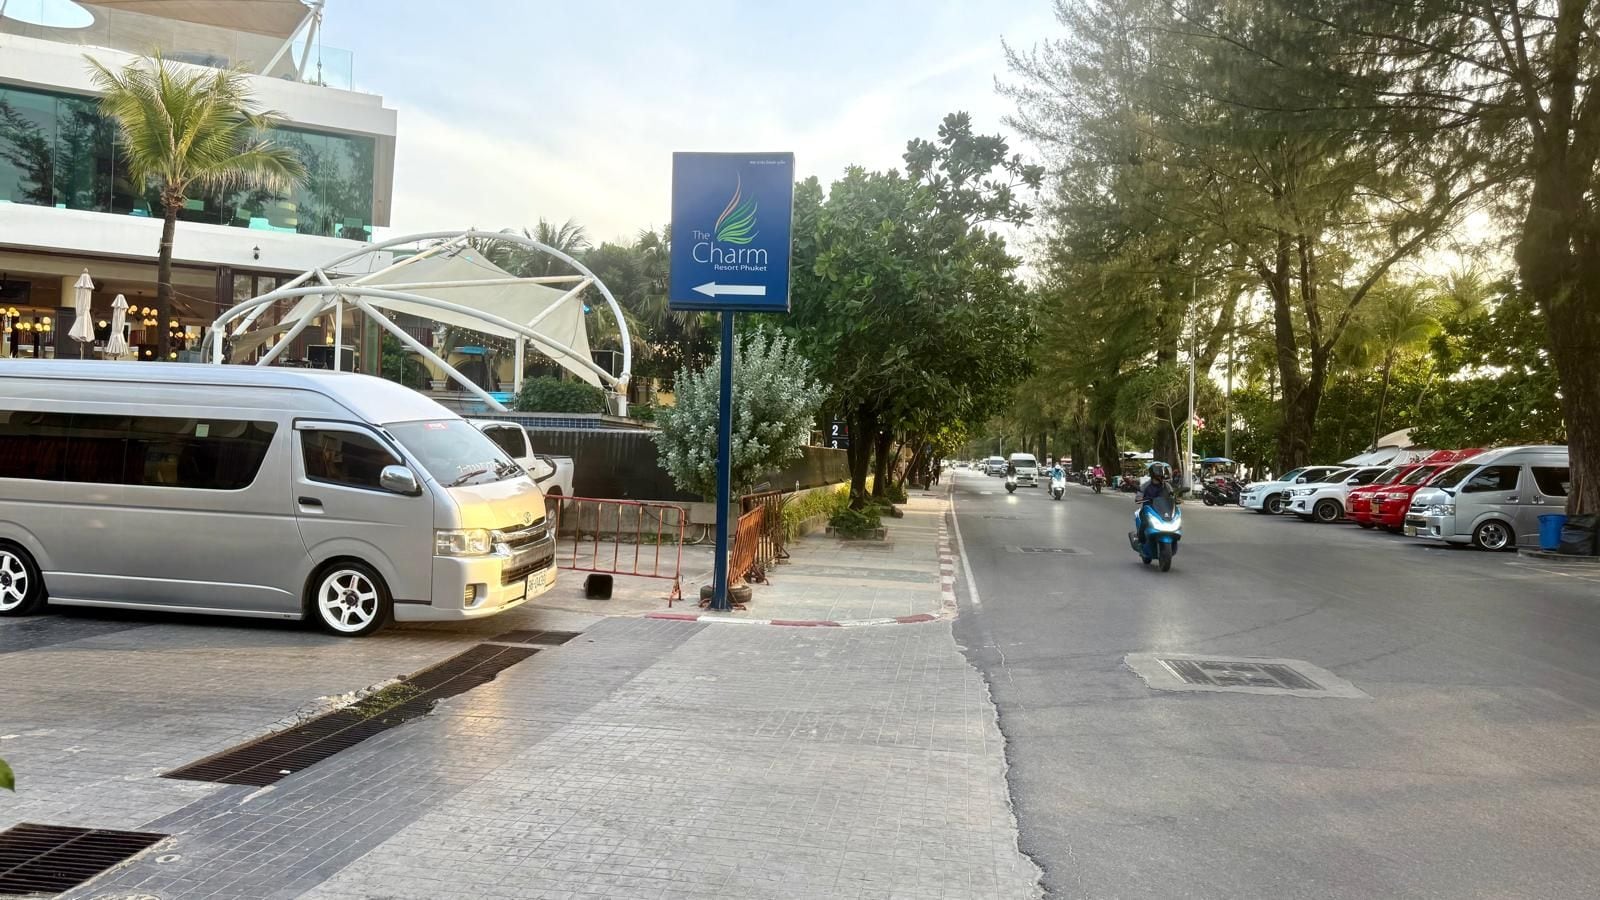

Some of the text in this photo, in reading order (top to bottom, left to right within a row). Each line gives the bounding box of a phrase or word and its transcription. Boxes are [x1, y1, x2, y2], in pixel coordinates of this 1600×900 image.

[692, 231, 710, 240] The
[692, 242, 768, 264] Charm
[832, 424, 839, 436] 2
